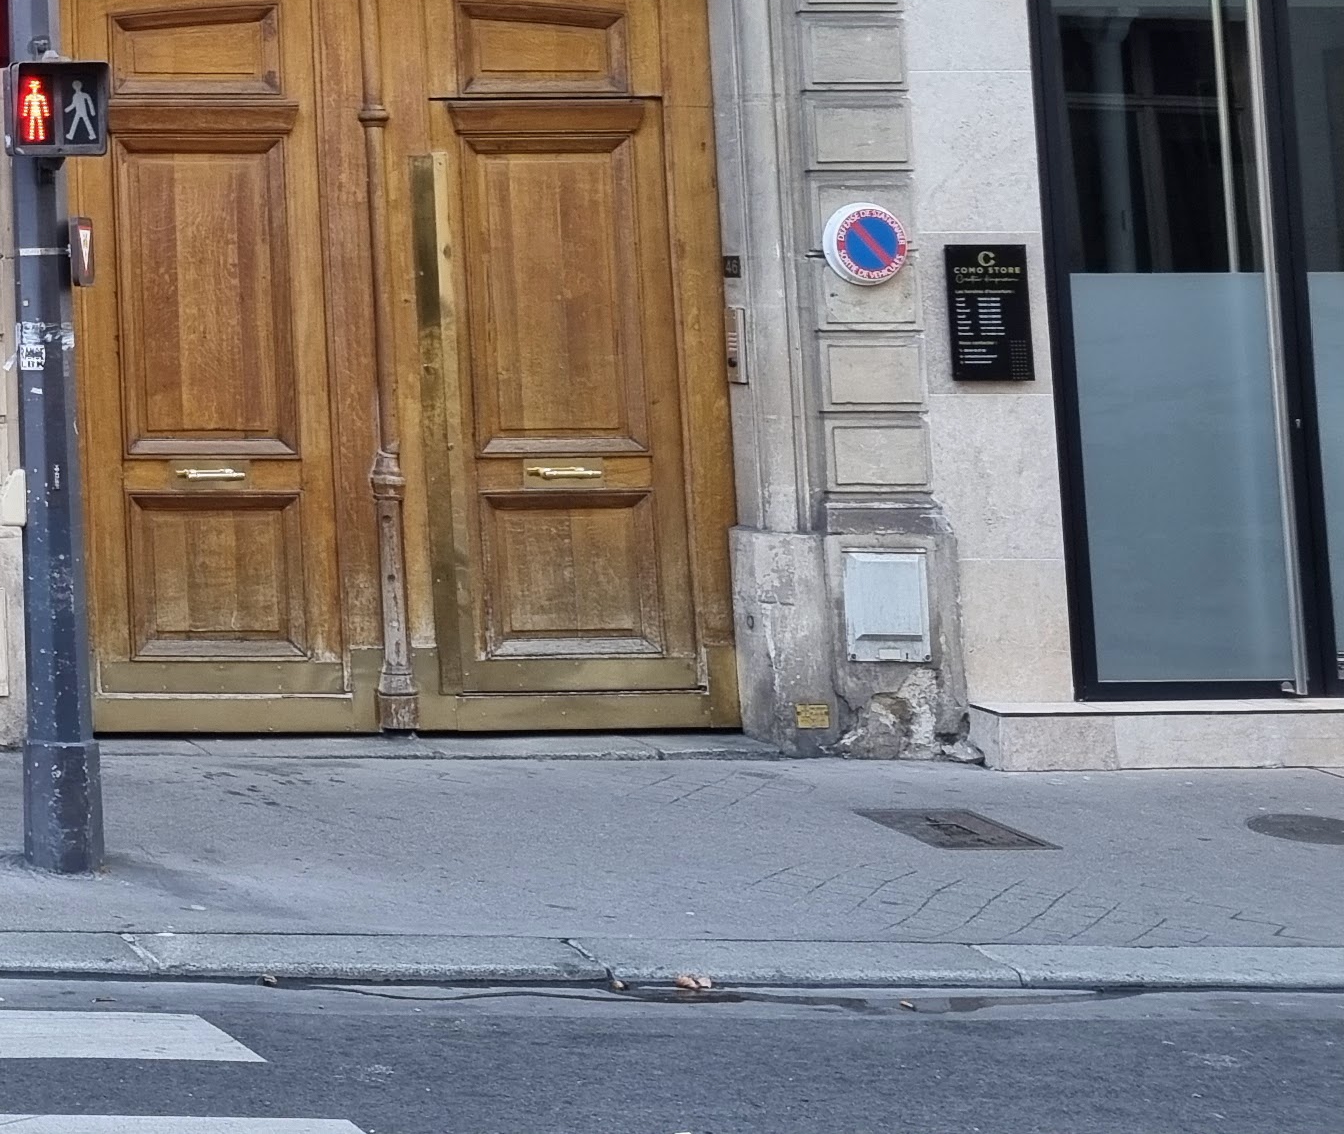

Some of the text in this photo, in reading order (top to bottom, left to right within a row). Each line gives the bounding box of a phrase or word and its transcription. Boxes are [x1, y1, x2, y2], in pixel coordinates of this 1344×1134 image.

[837, 212, 861, 241] DEFENSE
[839, 249, 859, 274] SORTIE
[953, 266, 1021, 274] COMO STORE
